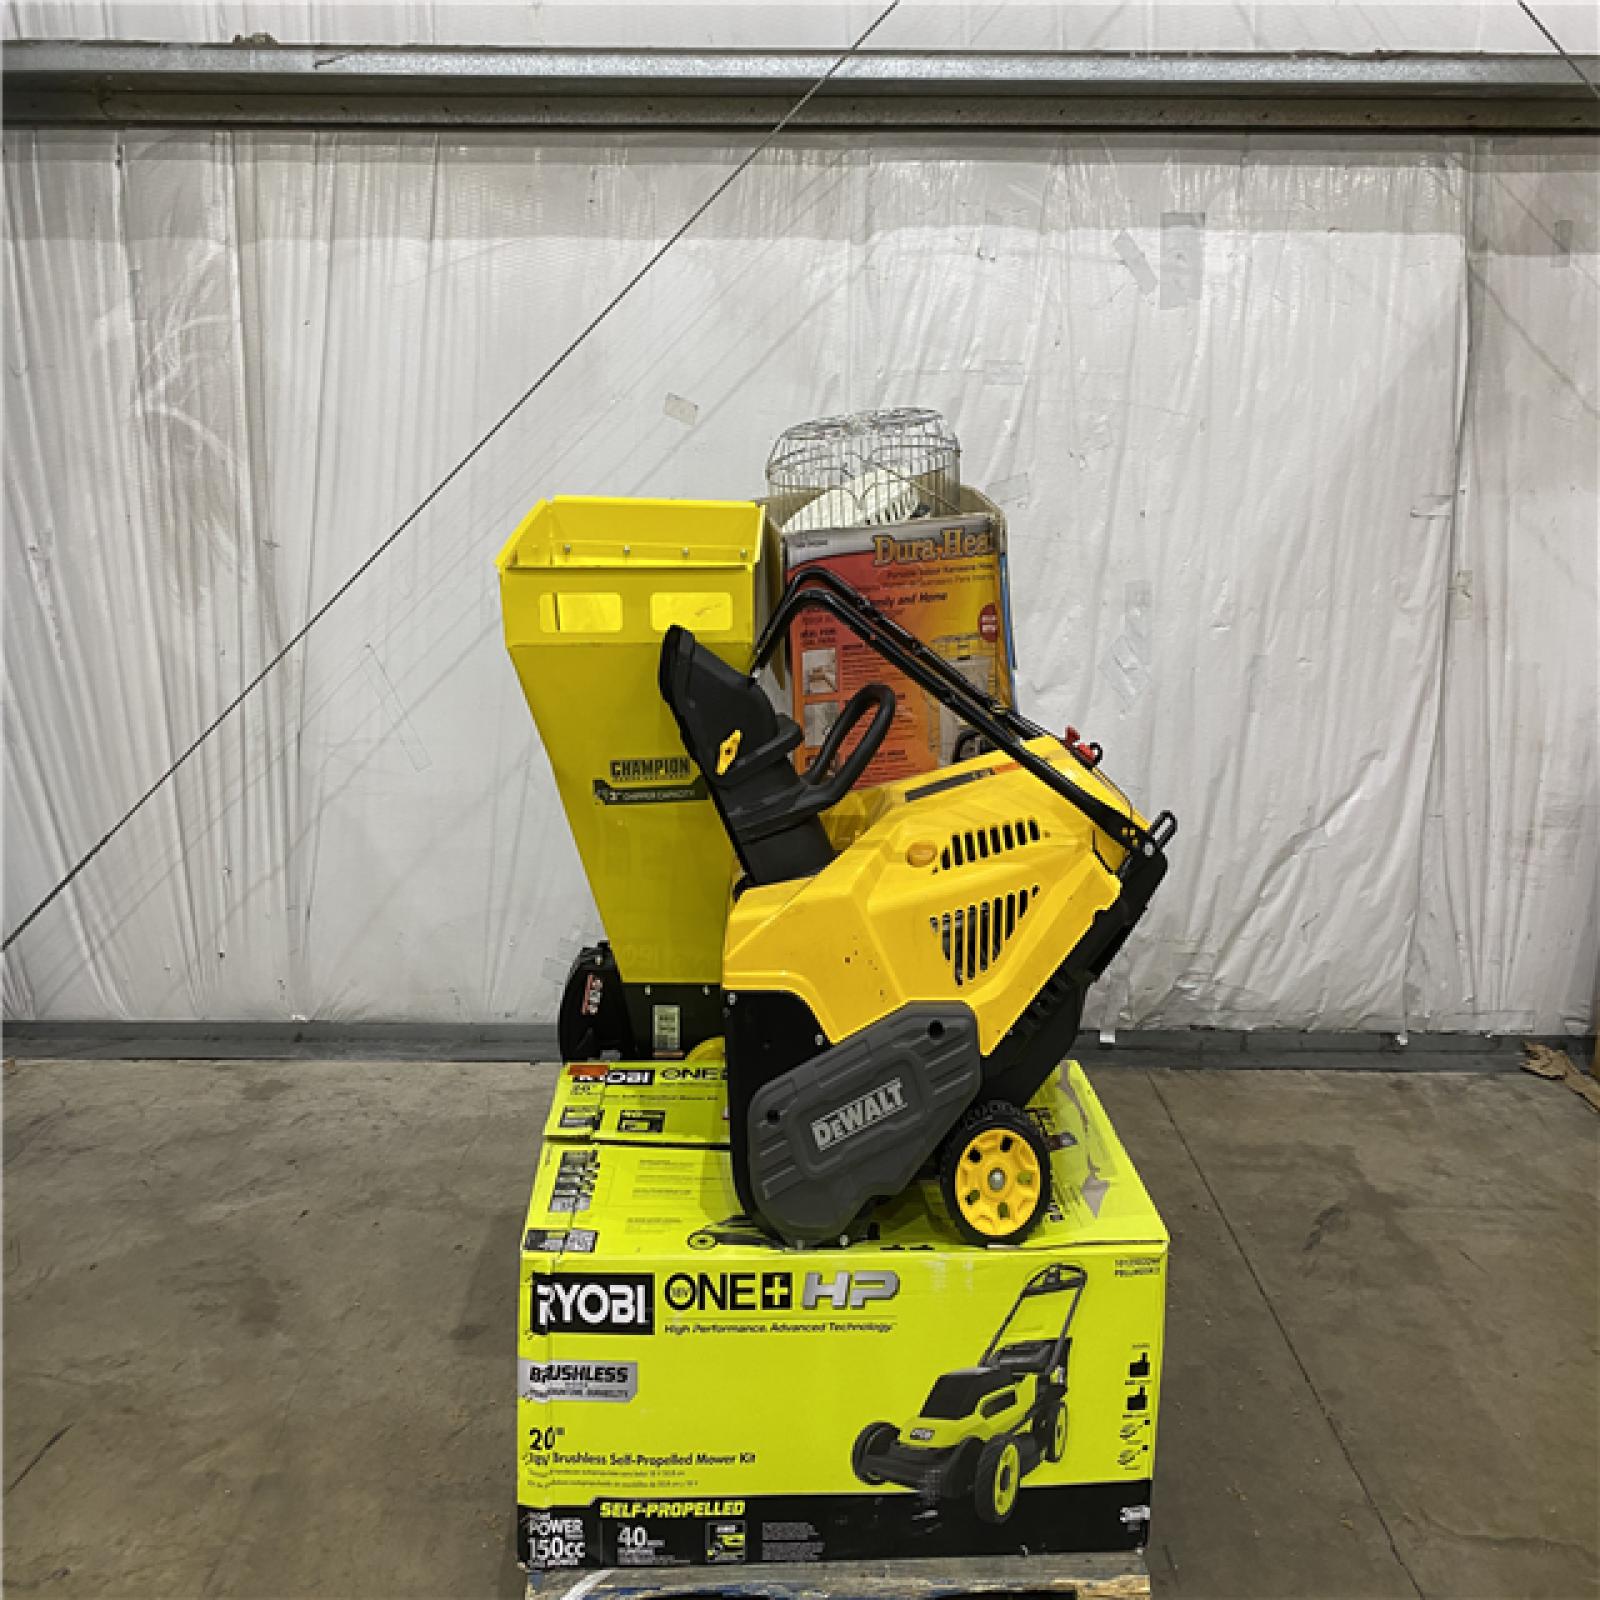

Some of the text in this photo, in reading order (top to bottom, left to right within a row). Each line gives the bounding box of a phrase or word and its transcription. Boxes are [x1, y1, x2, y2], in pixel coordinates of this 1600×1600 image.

[872, 535, 936, 566] Dura
[610, 758, 692, 776] CHAMPION
[537, 1283, 647, 1327] RYOBI
[802, 1270, 900, 1310] HP
[664, 1324, 690, 1336] High
[609, 1452, 693, 1468] Self-Propelled
[696, 1453, 736, 1465] Mower
[739, 1451, 756, 1464] Kit
[600, 1500, 746, 1518] SELF-PROPELLED
[617, 1526, 647, 1547] 40
[527, 1536, 586, 1560] 150cc
